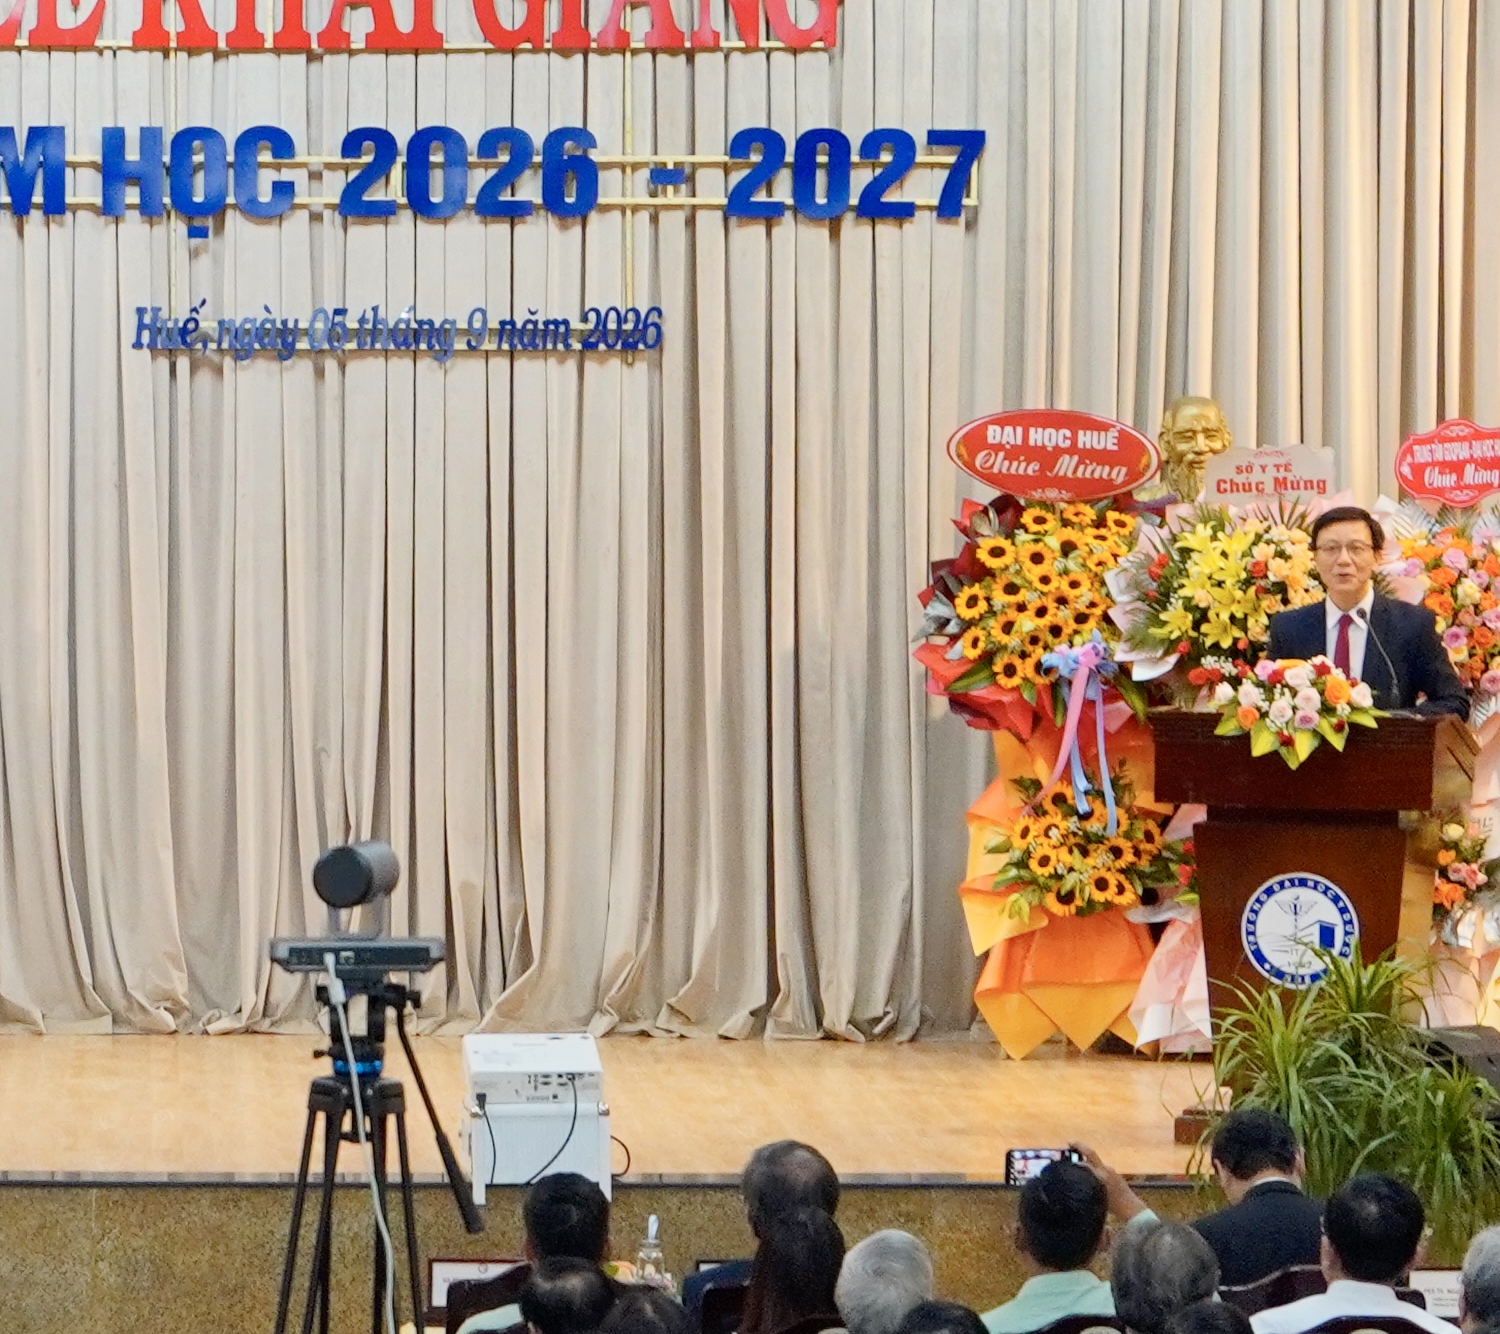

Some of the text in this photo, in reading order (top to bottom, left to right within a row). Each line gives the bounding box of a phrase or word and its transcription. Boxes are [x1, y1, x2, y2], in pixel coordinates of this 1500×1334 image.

[101, 125, 296, 240] HỌC
[339, 125, 600, 220] 2026
[649, 167, 687, 187] -
[725, 125, 987, 220] 2027
[132, 298, 663, 362] Huế, ngày 05 tháng 9 năm 2026
[987, 424, 1119, 452] ĐẠI HỌC HUẾ
[974, 449, 1129, 484] Chúc Mừng
[1236, 459, 1293, 475] SỞ Y TẾ
[1216, 475, 1327, 495] Chúc Mừng
